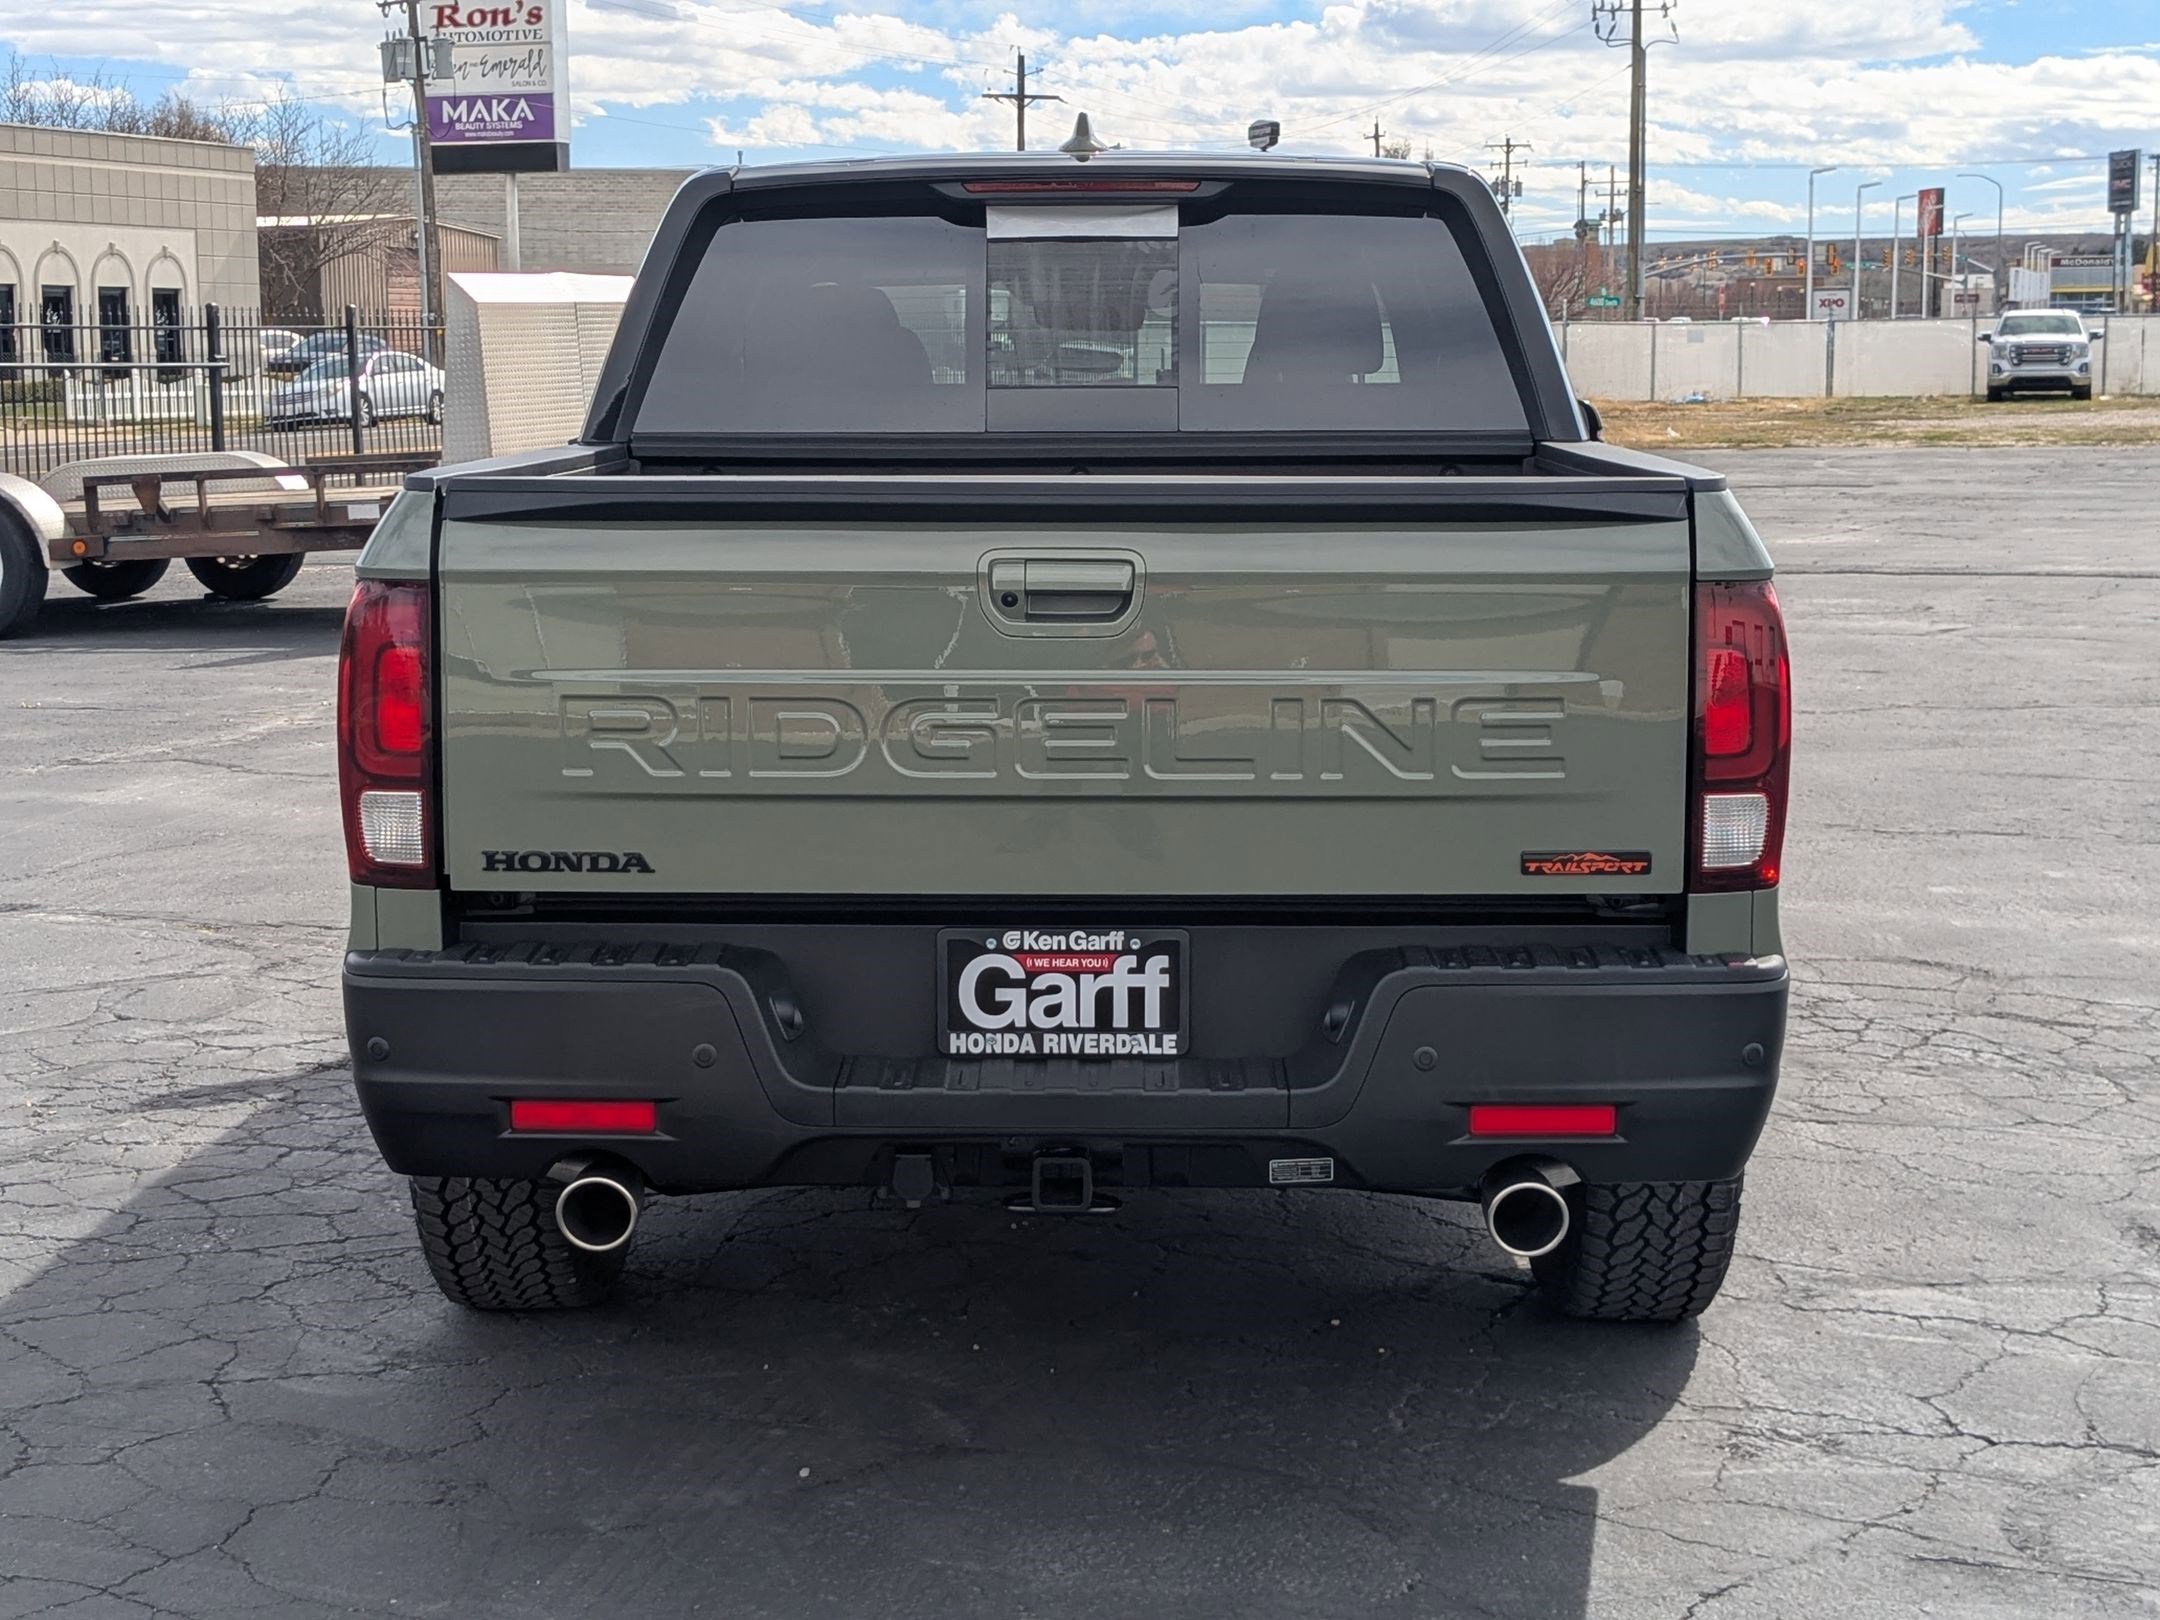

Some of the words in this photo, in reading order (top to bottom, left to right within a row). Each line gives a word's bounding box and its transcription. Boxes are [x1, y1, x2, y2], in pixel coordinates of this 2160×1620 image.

[430, 0, 544, 29] Ron's
[442, 29, 544, 43] UTOMOTIVE
[480, 47, 548, 79] Emerald
[441, 97, 535, 123] MAKA
[454, 121, 485, 131] BEAUTY
[486, 120, 523, 130] SYSTEMS
[559, 693, 1567, 781] RIDGELINE
[482, 850, 655, 874] HONDA
[1525, 861, 1649, 874] TRAILSPORT
[1023, 930, 1066, 951] Ken
[1069, 930, 1125, 951] Garff
[1034, 958, 1050, 968] WE
[1052, 958, 1079, 968] HEAR
[1081, 958, 1102, 968] YOU
[958, 953, 1170, 1030] Garff
[949, 1033, 1037, 1055] HONDA
[1042, 1033, 1178, 1055] RIVERDALE
